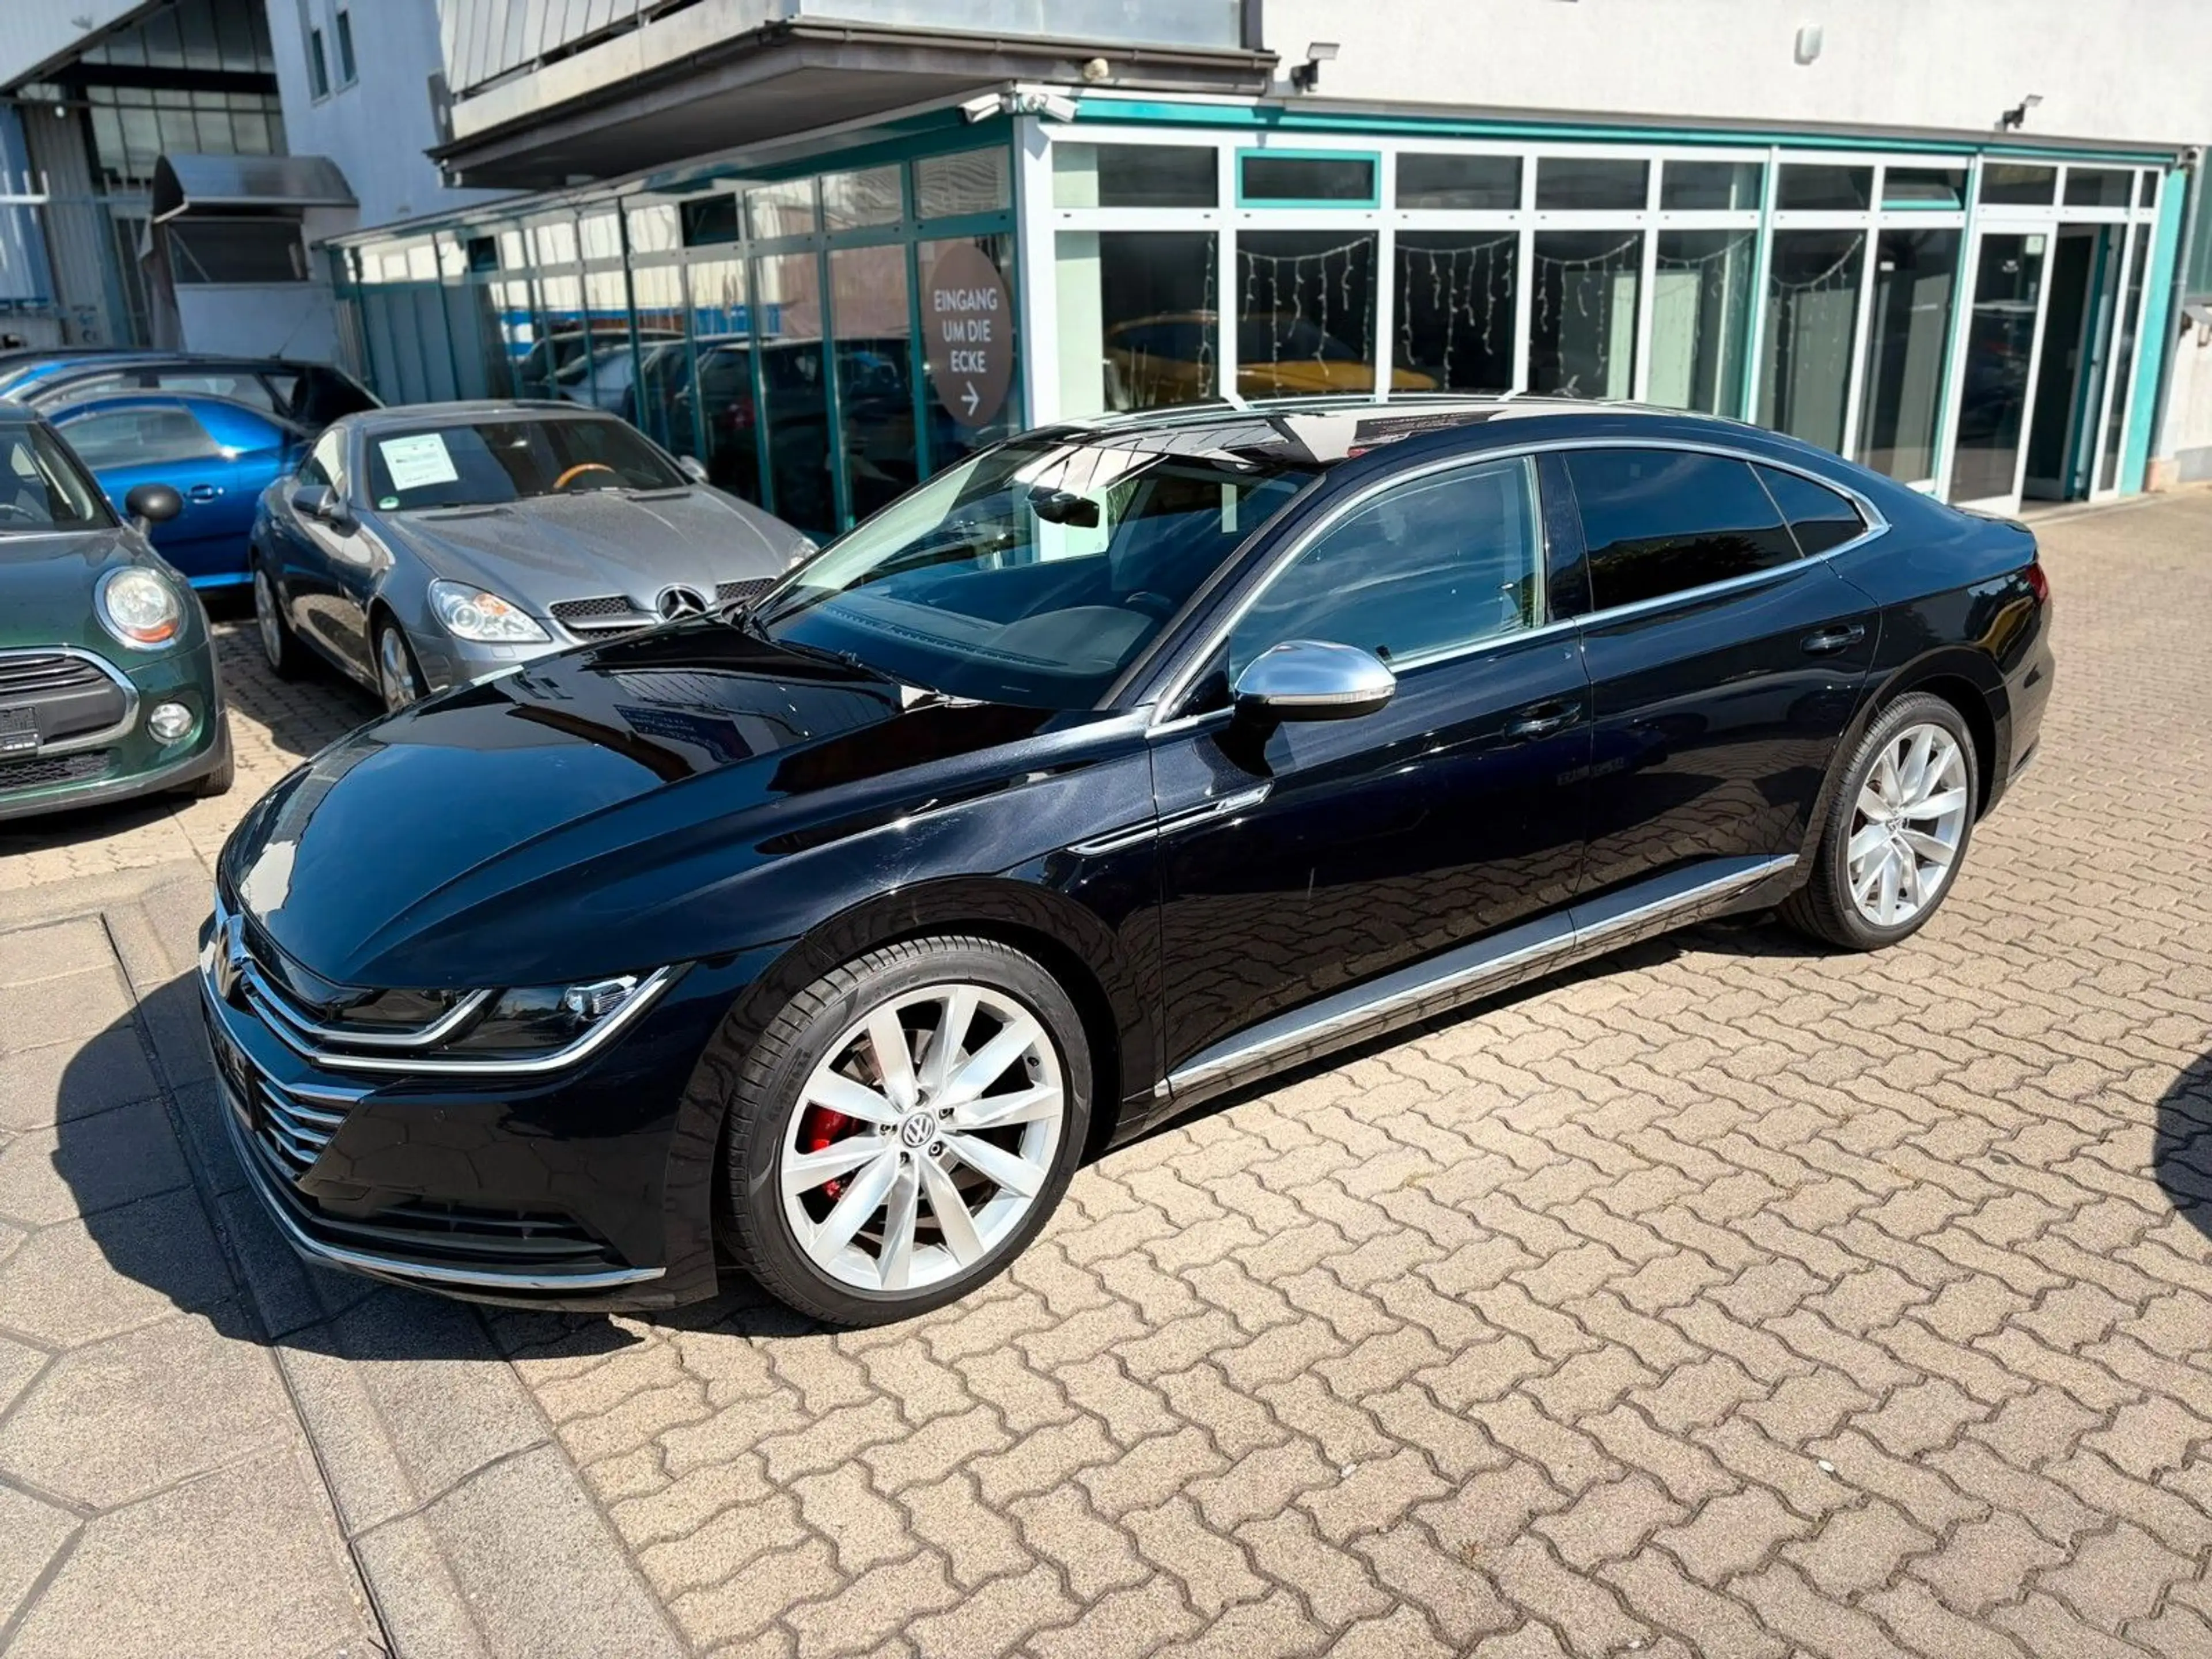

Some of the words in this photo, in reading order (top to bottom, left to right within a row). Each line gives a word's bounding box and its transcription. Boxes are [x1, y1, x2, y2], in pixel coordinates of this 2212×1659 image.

[933, 288, 998, 312] EINGANG
[942, 320, 965, 342] UM
[968, 320, 991, 342] DIE
[950, 351, 986, 373] ECKE
